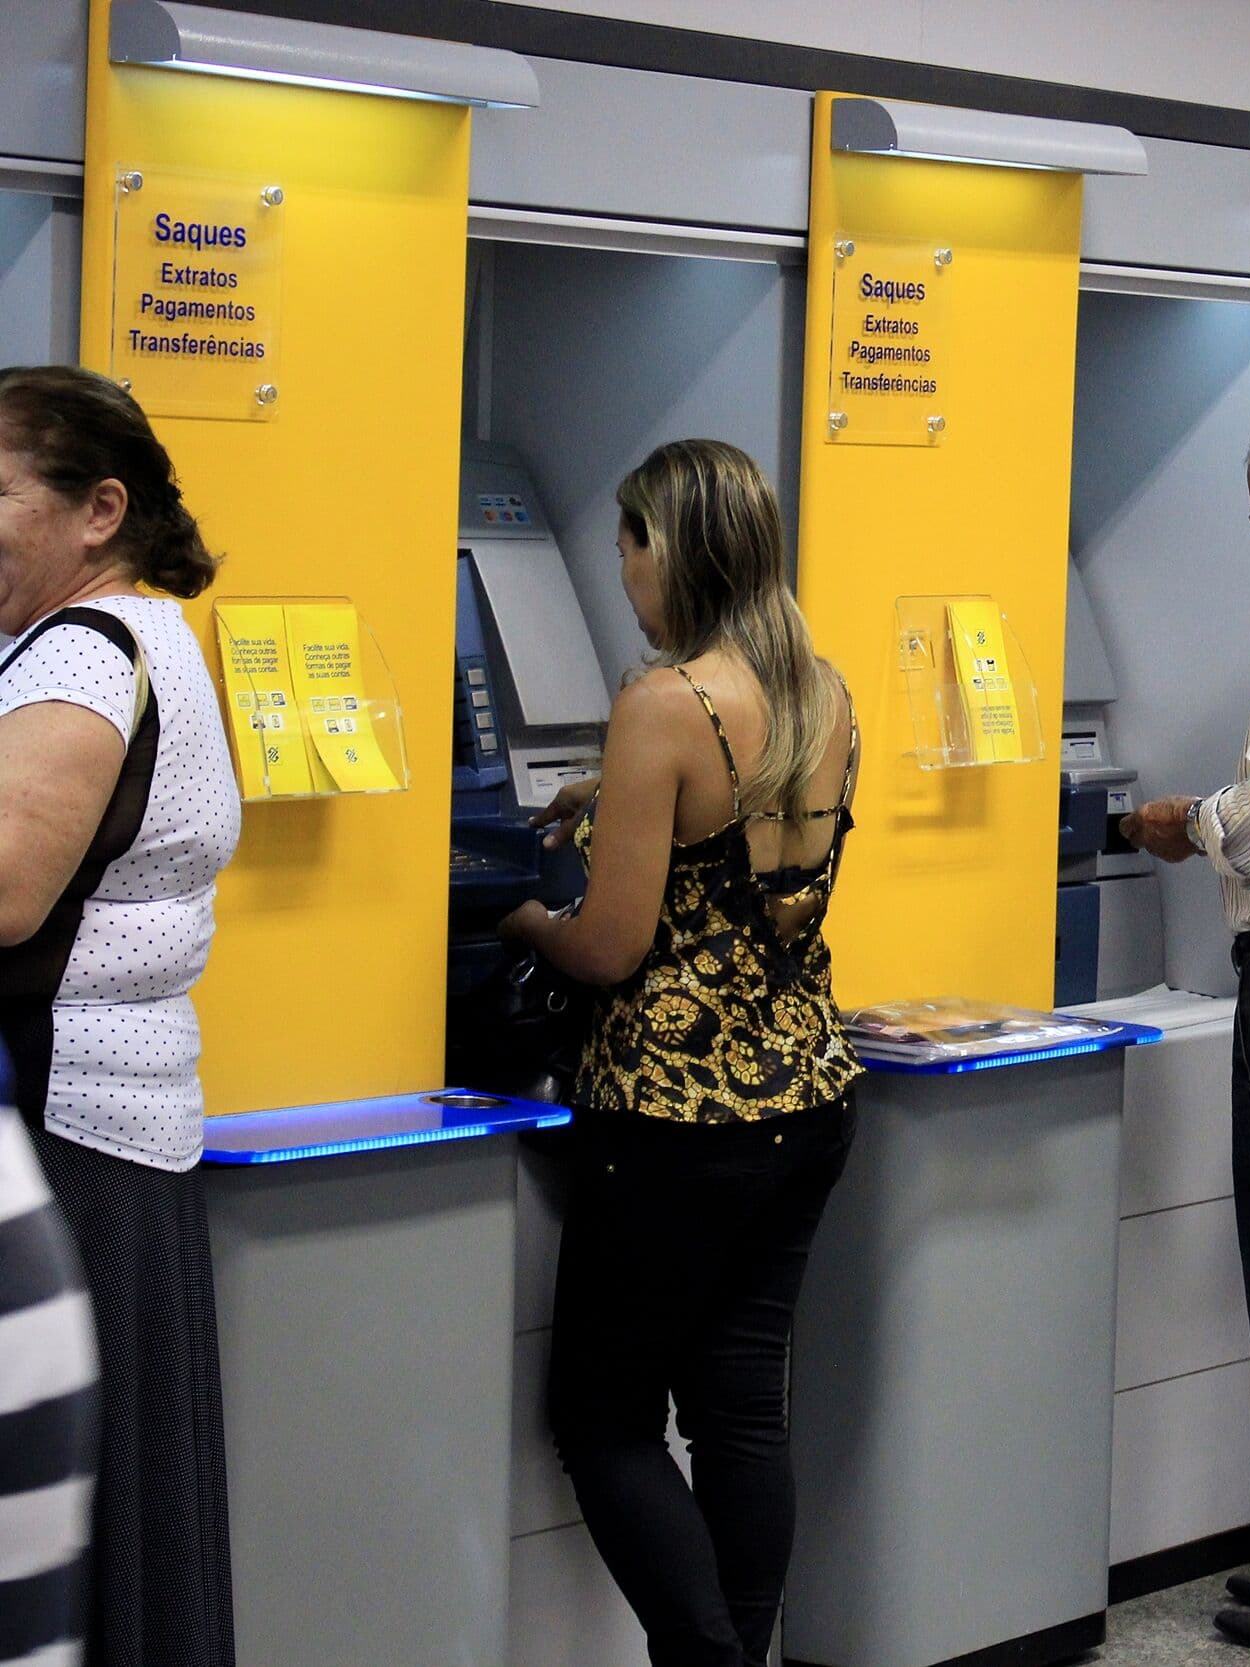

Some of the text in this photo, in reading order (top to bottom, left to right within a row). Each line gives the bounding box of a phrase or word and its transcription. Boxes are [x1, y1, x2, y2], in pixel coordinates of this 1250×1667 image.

[155, 213, 247, 251] Saques
[161, 262, 238, 288] Extratos
[861, 273, 926, 304] Saques
[141, 293, 256, 322] Pagamentos
[865, 314, 919, 335] Extratos
[129, 329, 265, 358] Transferências
[850, 341, 931, 364] Pagamentos
[842, 371, 937, 393] Transferências
[303, 643, 323, 651] Facilite
[305, 653, 331, 661] Conheça
[262, 658, 279, 666] pagar
[335, 662, 352, 670] pagar
